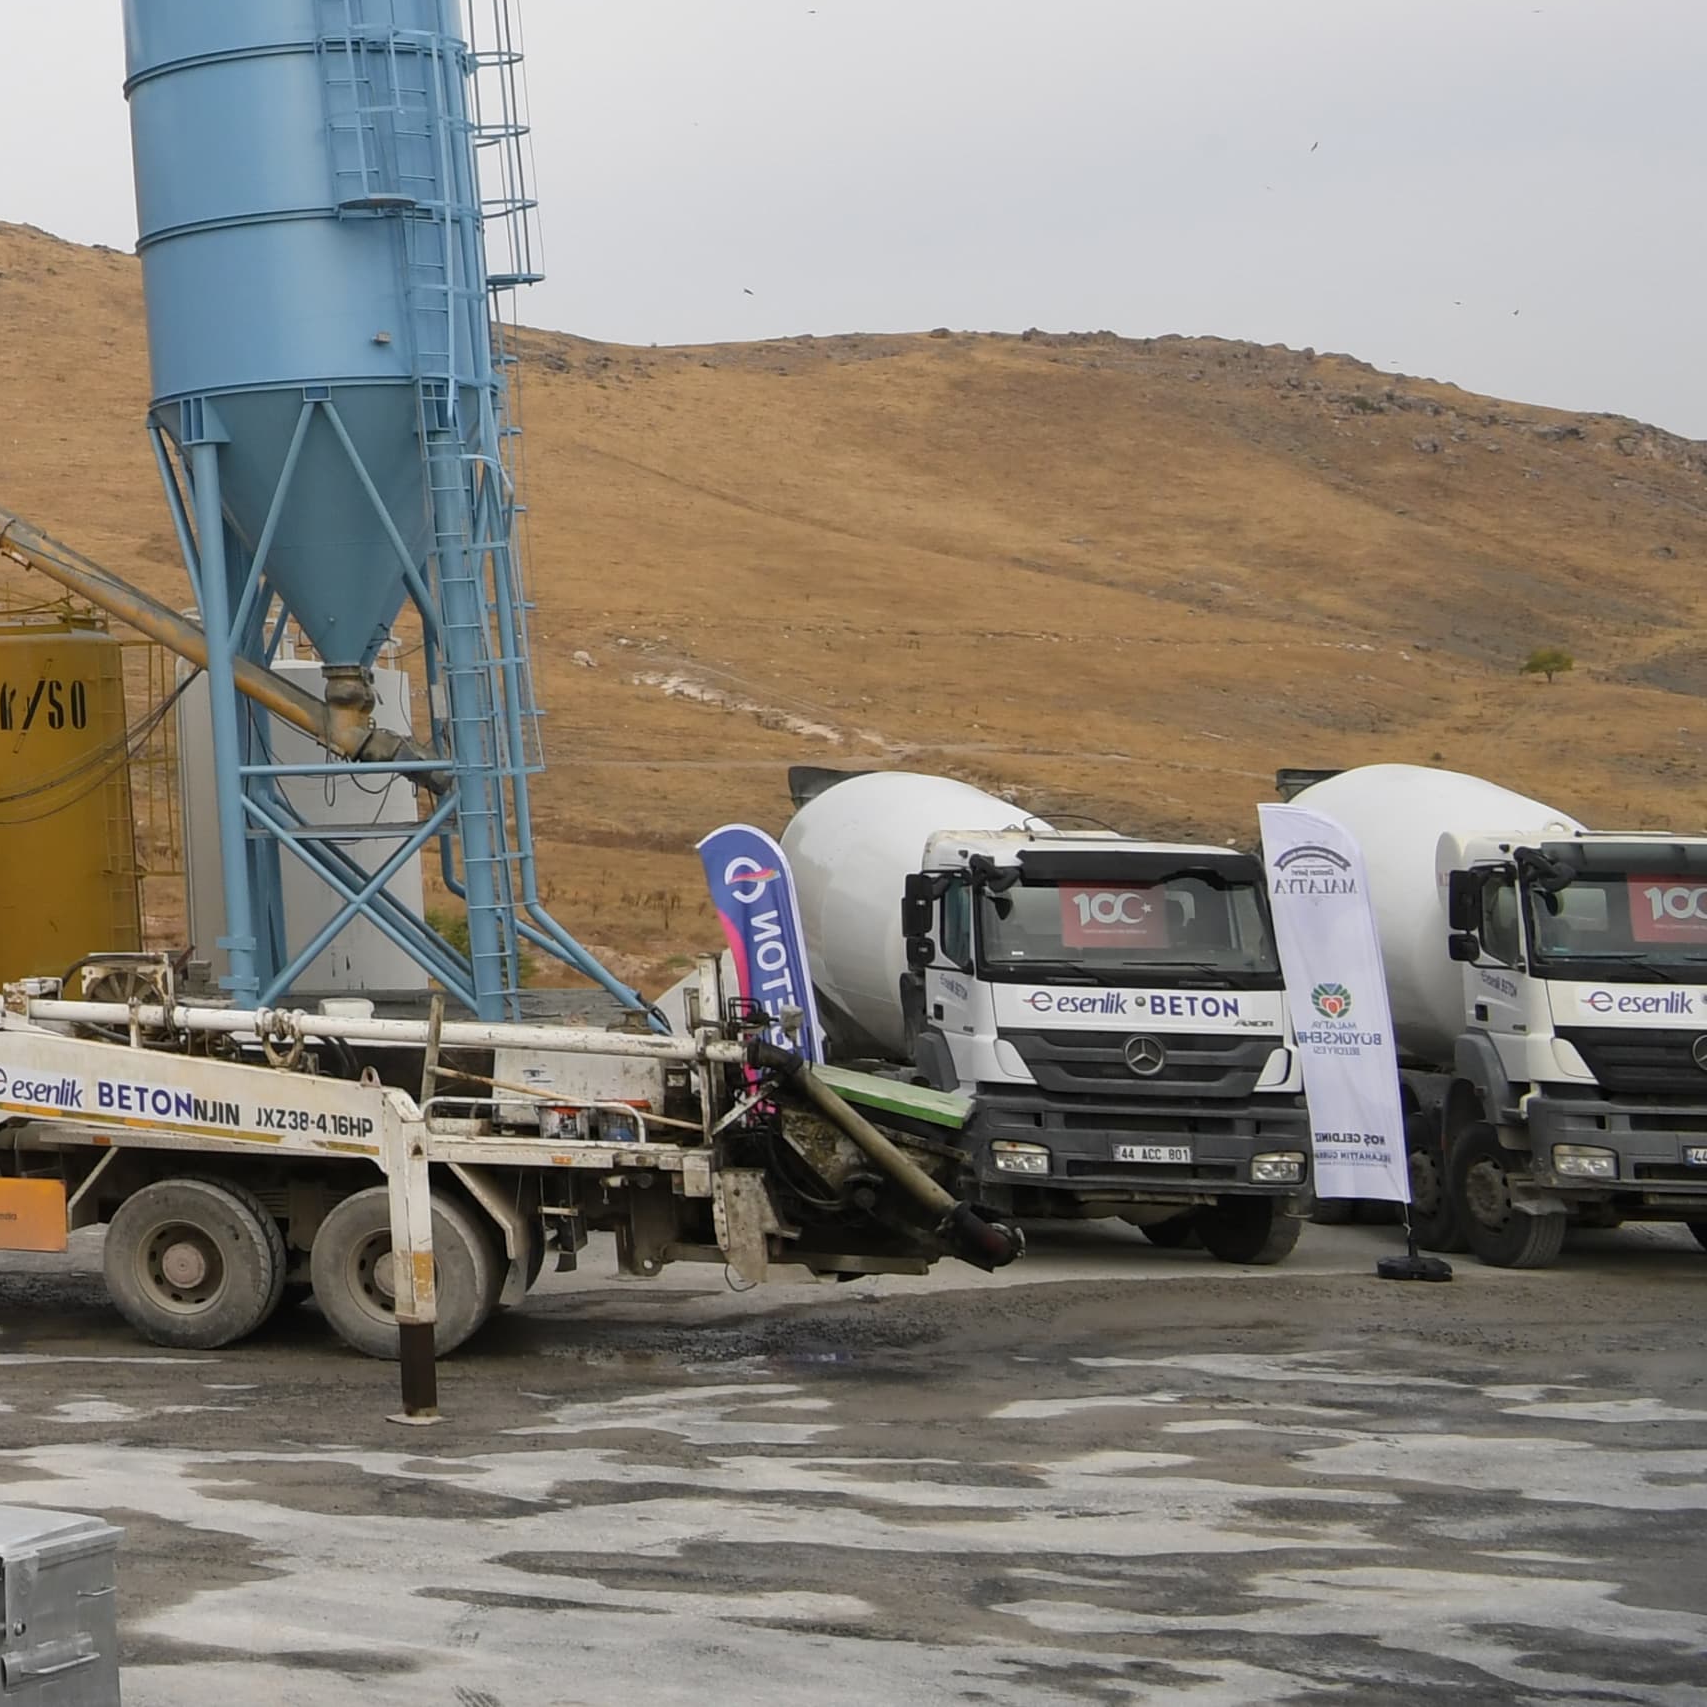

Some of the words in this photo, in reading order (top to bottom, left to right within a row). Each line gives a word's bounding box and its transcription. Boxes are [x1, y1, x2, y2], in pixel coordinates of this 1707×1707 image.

[1057, 992, 1128, 1014] esenlik
[1150, 995, 1239, 1017] BETON
[1618, 991, 1693, 1014] esenlik
[12, 1078, 83, 1108] esenlik
[98, 1081, 193, 1118] BETON
[1121, 1147, 1135, 1159] 44
